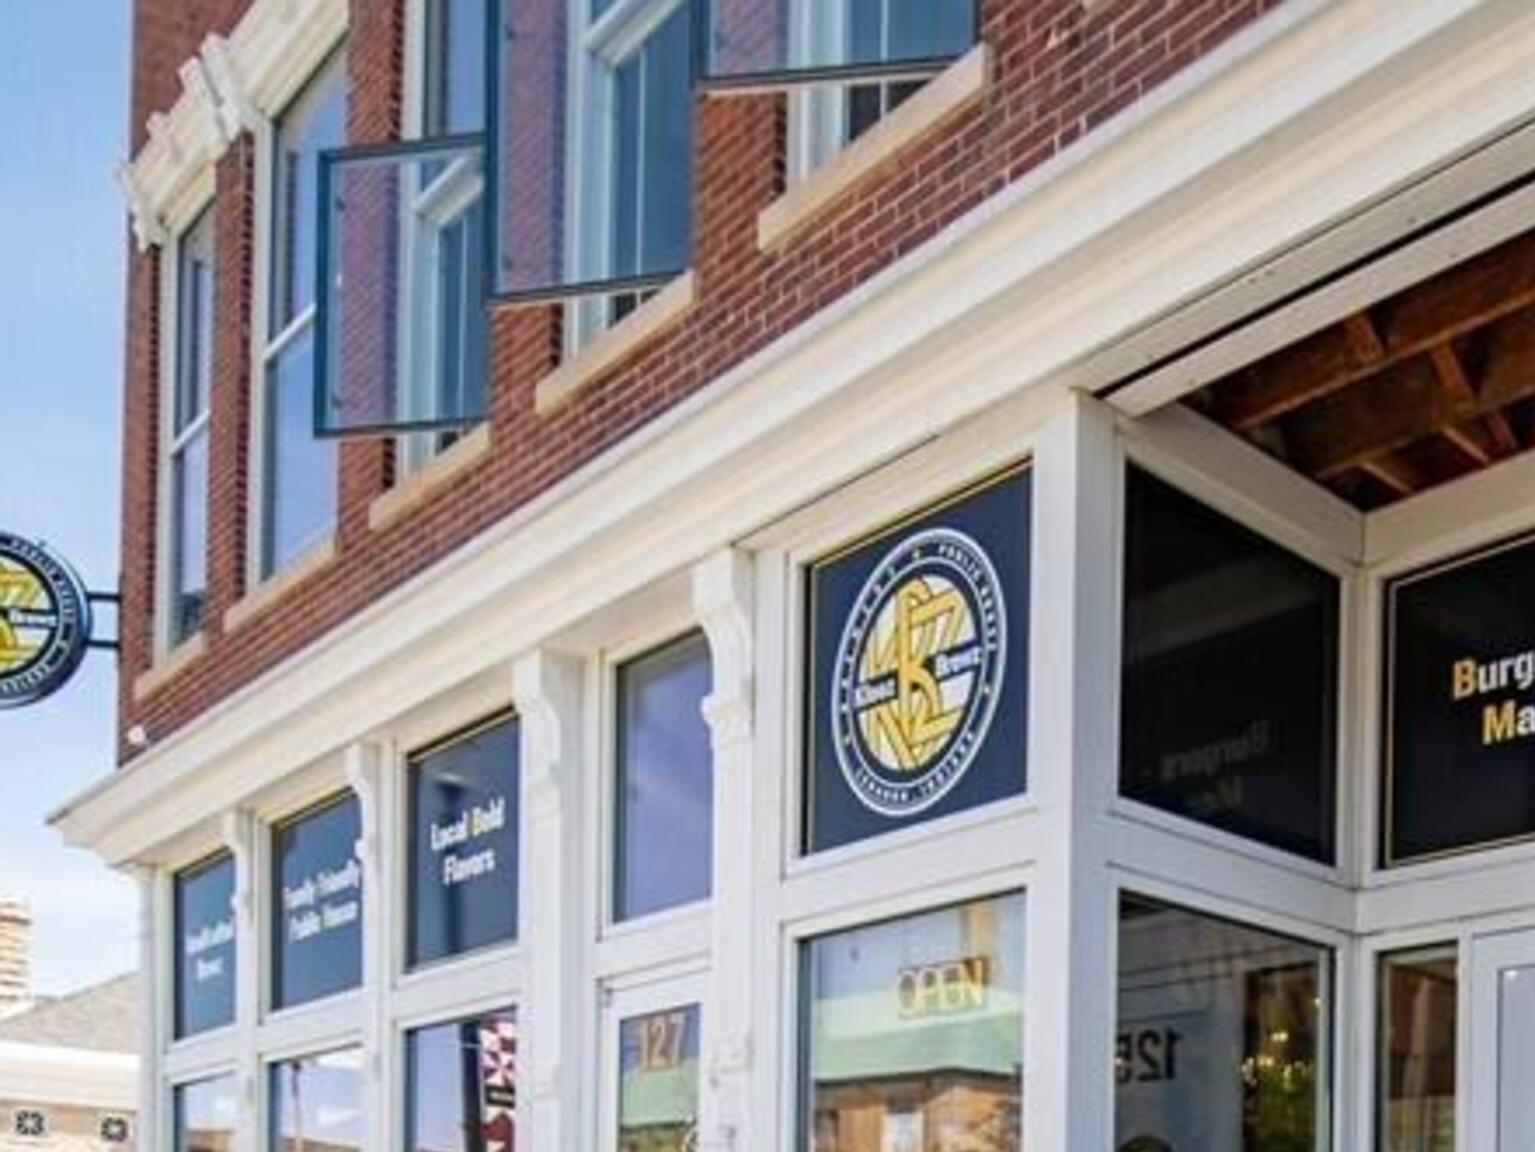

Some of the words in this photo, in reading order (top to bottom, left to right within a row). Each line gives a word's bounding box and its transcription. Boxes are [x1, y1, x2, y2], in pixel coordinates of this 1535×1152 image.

[431, 810, 468, 851] Local
[472, 797, 505, 837] Bold
[443, 849, 496, 885] Flavors
[896, 957, 986, 1015] OPEN
